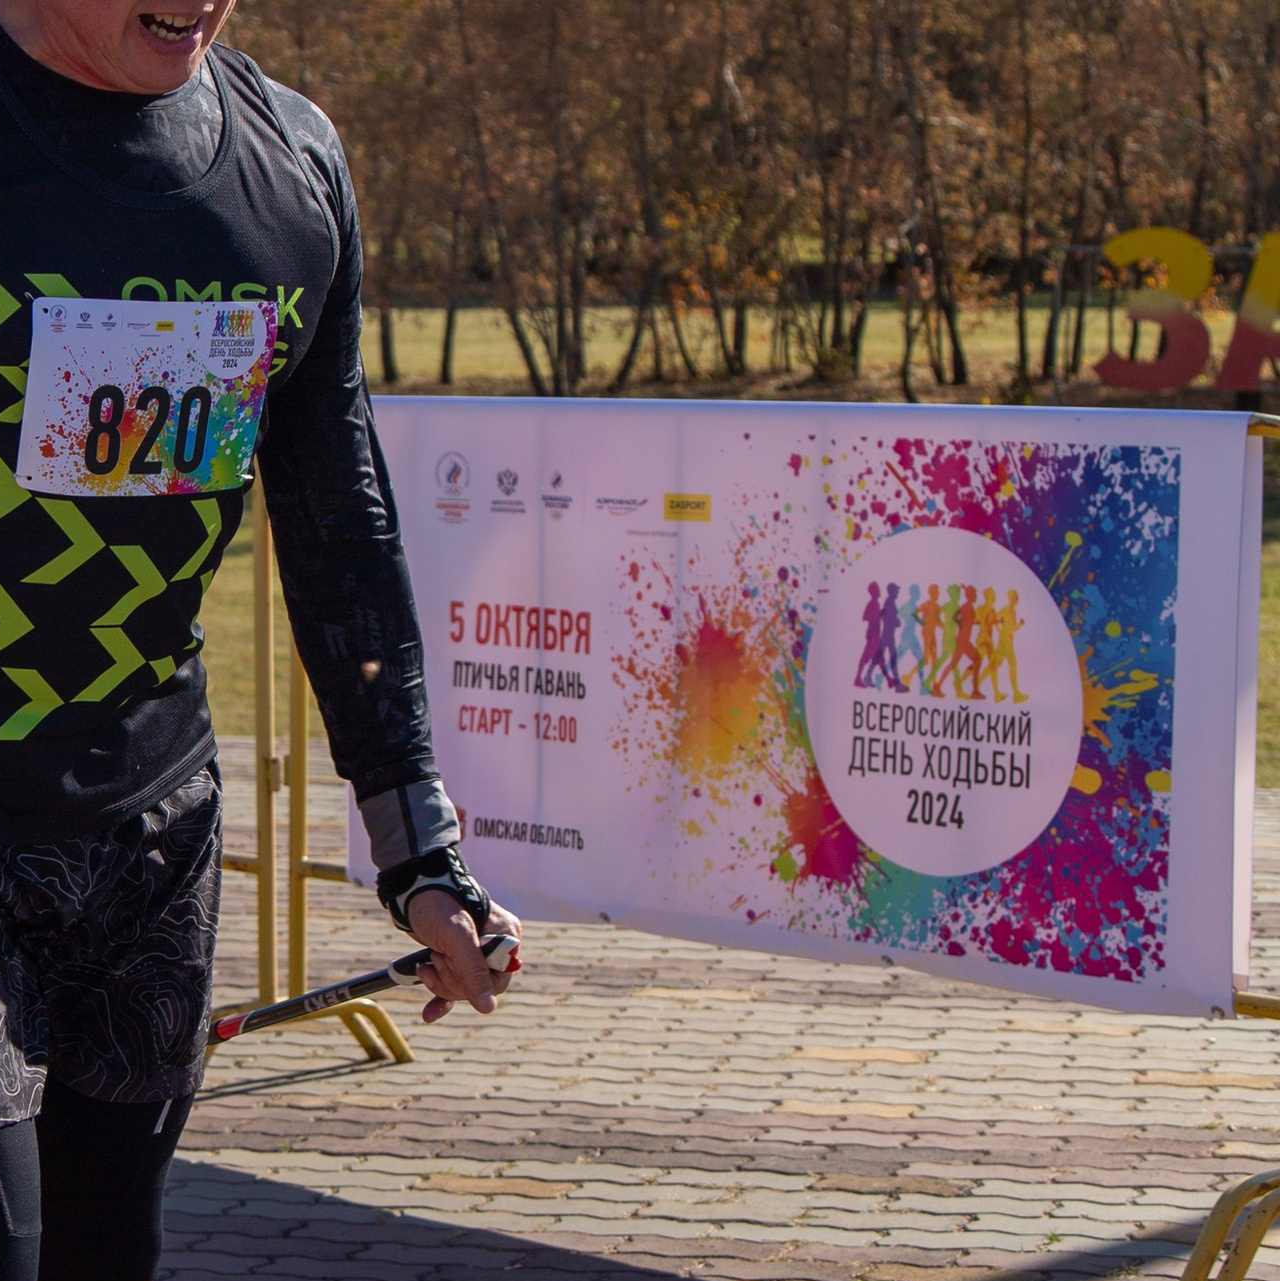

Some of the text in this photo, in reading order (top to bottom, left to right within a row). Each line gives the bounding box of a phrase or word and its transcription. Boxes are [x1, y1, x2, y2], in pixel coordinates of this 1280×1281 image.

[209, 347, 254, 359] ДЕНЬ ХОДЬБЫ
[210, 338, 255, 348] ВСЕРОССИЙСКИЙ
[222, 359, 238, 369] 2024
[84, 384, 212, 476] 820
[669, 499, 707, 512] ZASPORT
[449, 599, 592, 655] 5 ОКТЯБРЯ
[452, 659, 587, 700] ПТИЧЬЯ ГАВАНЬ
[458, 704, 513, 736] СТАРТ
[534, 712, 578, 744] 12:00
[852, 700, 1032, 747] ВСЕРОССИЙСКИЙ
[848, 736, 1031, 789] ДЕНЬ ХОДЬБЫ
[907, 788, 965, 830] 2024
[474, 817, 585, 851] ОМСКАЯ ОБЛАСТЬ
